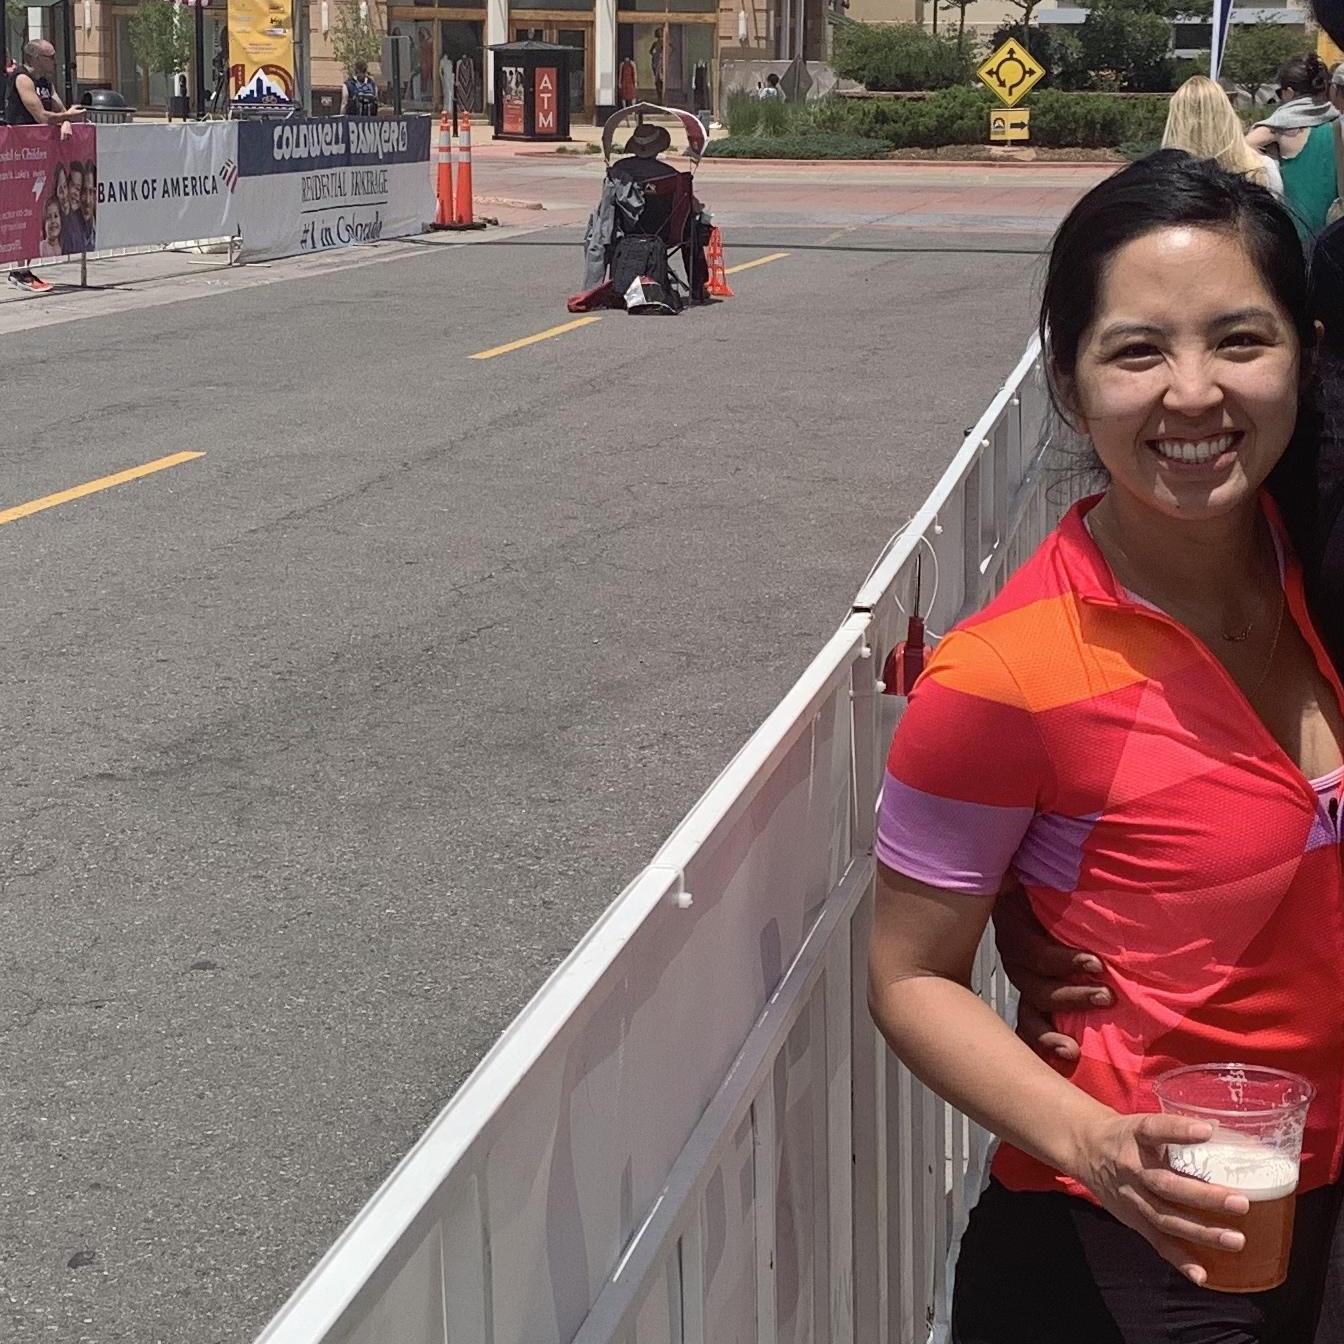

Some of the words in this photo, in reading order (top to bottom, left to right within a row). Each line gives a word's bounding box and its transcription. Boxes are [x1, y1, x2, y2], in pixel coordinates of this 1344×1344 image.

[538, 73, 554, 128] ATM
[273, 121, 346, 160] COLDWELL
[97, 179, 138, 204] BANK
[141, 178, 156, 201] OF
[161, 175, 219, 200] AMERICA
[320, 219, 336, 247] in
